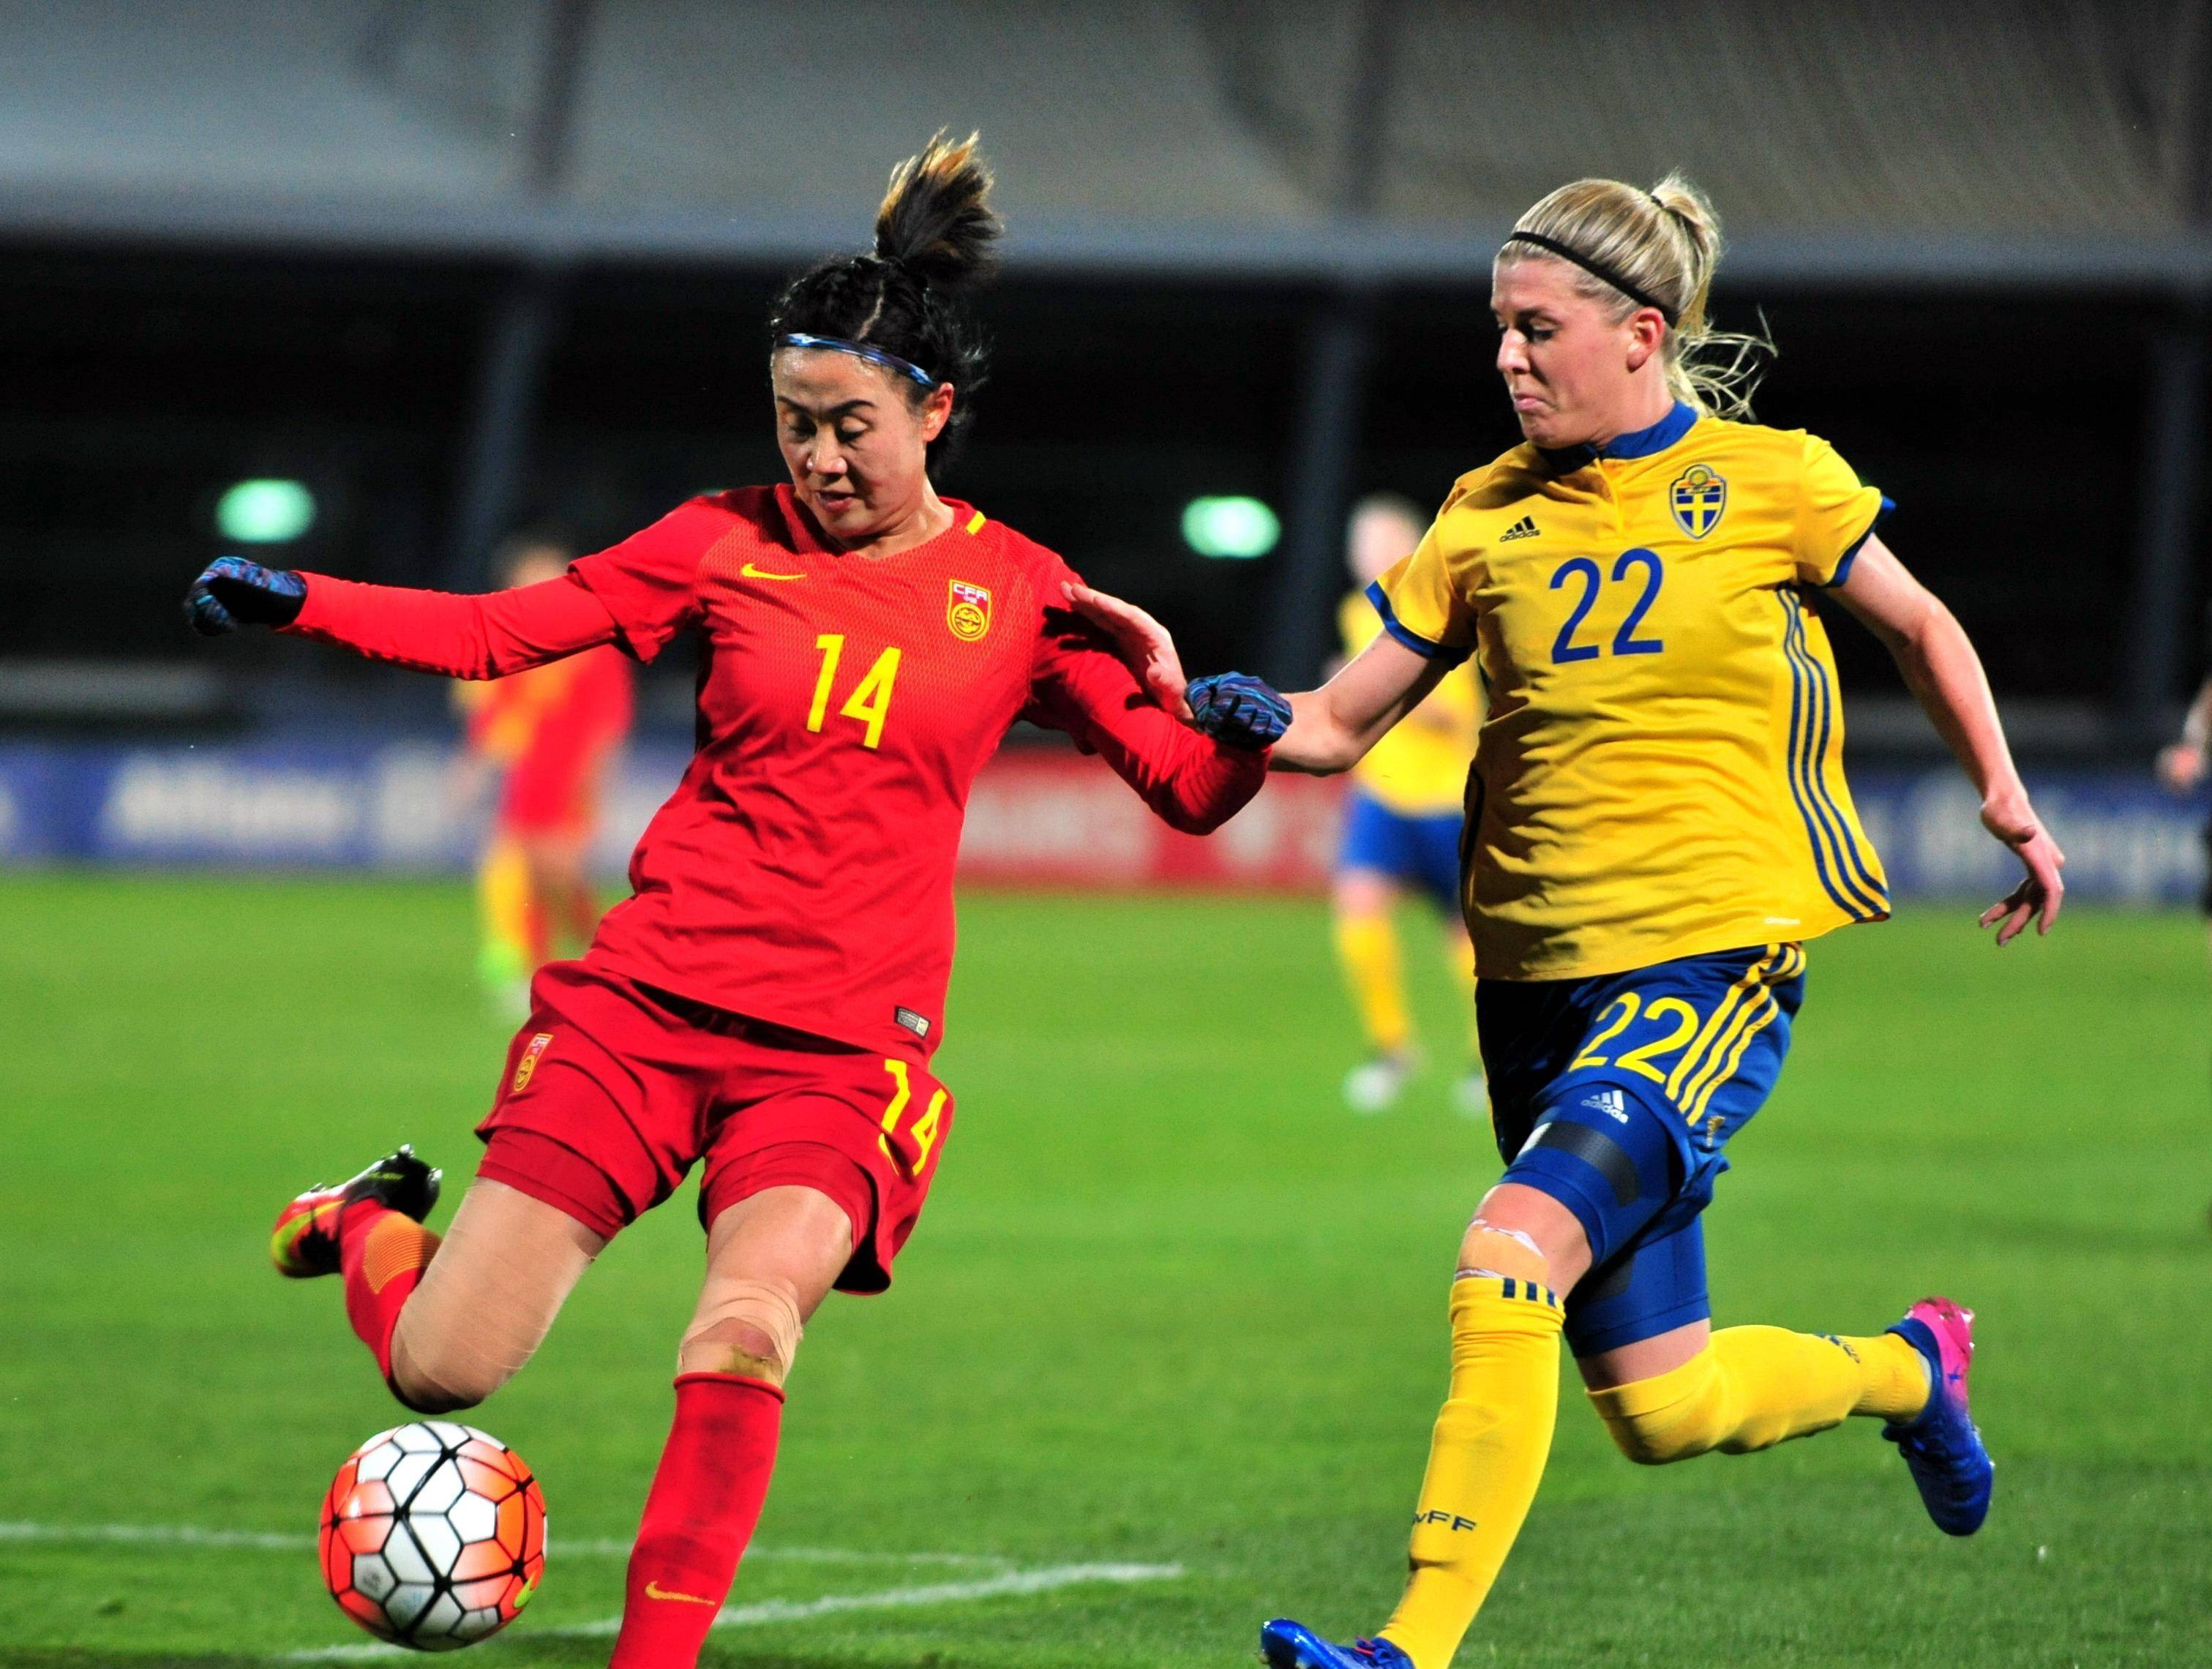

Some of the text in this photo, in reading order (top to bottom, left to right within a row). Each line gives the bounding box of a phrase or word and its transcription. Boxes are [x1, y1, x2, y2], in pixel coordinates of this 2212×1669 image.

[953, 583, 988, 601] CFA
[1549, 548, 1663, 664] 22
[806, 634, 901, 749] 14
[1568, 992, 1698, 1084] 22
[879, 1059, 947, 1176] 14
[1581, 1100, 1629, 1124] adidas
[1412, 1510, 1477, 1531] vFF
